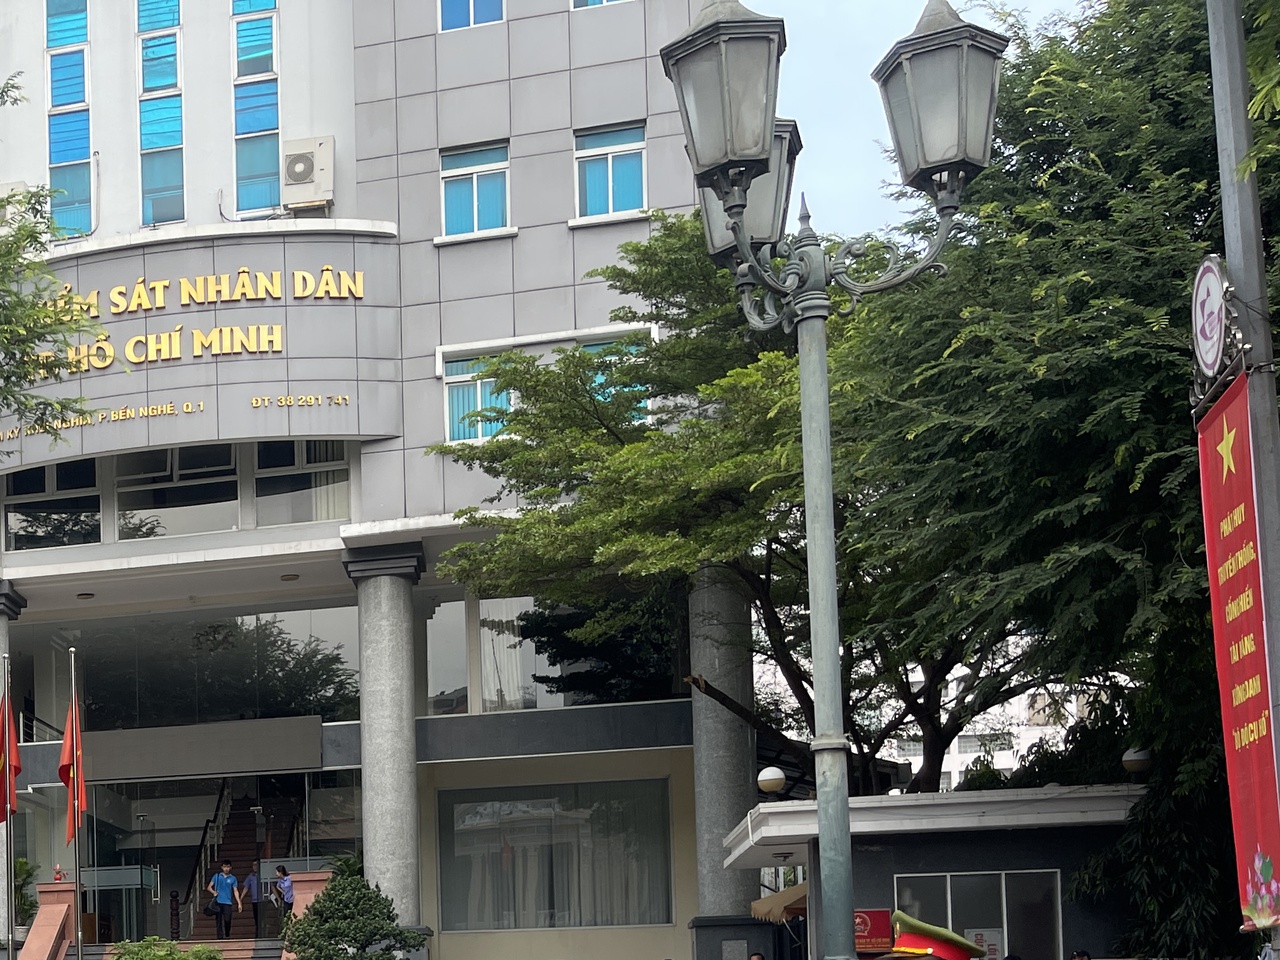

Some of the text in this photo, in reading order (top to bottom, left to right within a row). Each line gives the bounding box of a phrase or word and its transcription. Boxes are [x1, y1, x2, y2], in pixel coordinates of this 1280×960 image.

[109, 276, 170, 314] SÁT
[179, 266, 282, 306] NHÂN
[292, 264, 364, 299] DÂN
[124, 324, 183, 364] CHÍ
[192, 324, 283, 358] MINH
[276, 395, 294, 406] 38
[297, 394, 322, 407] 291
